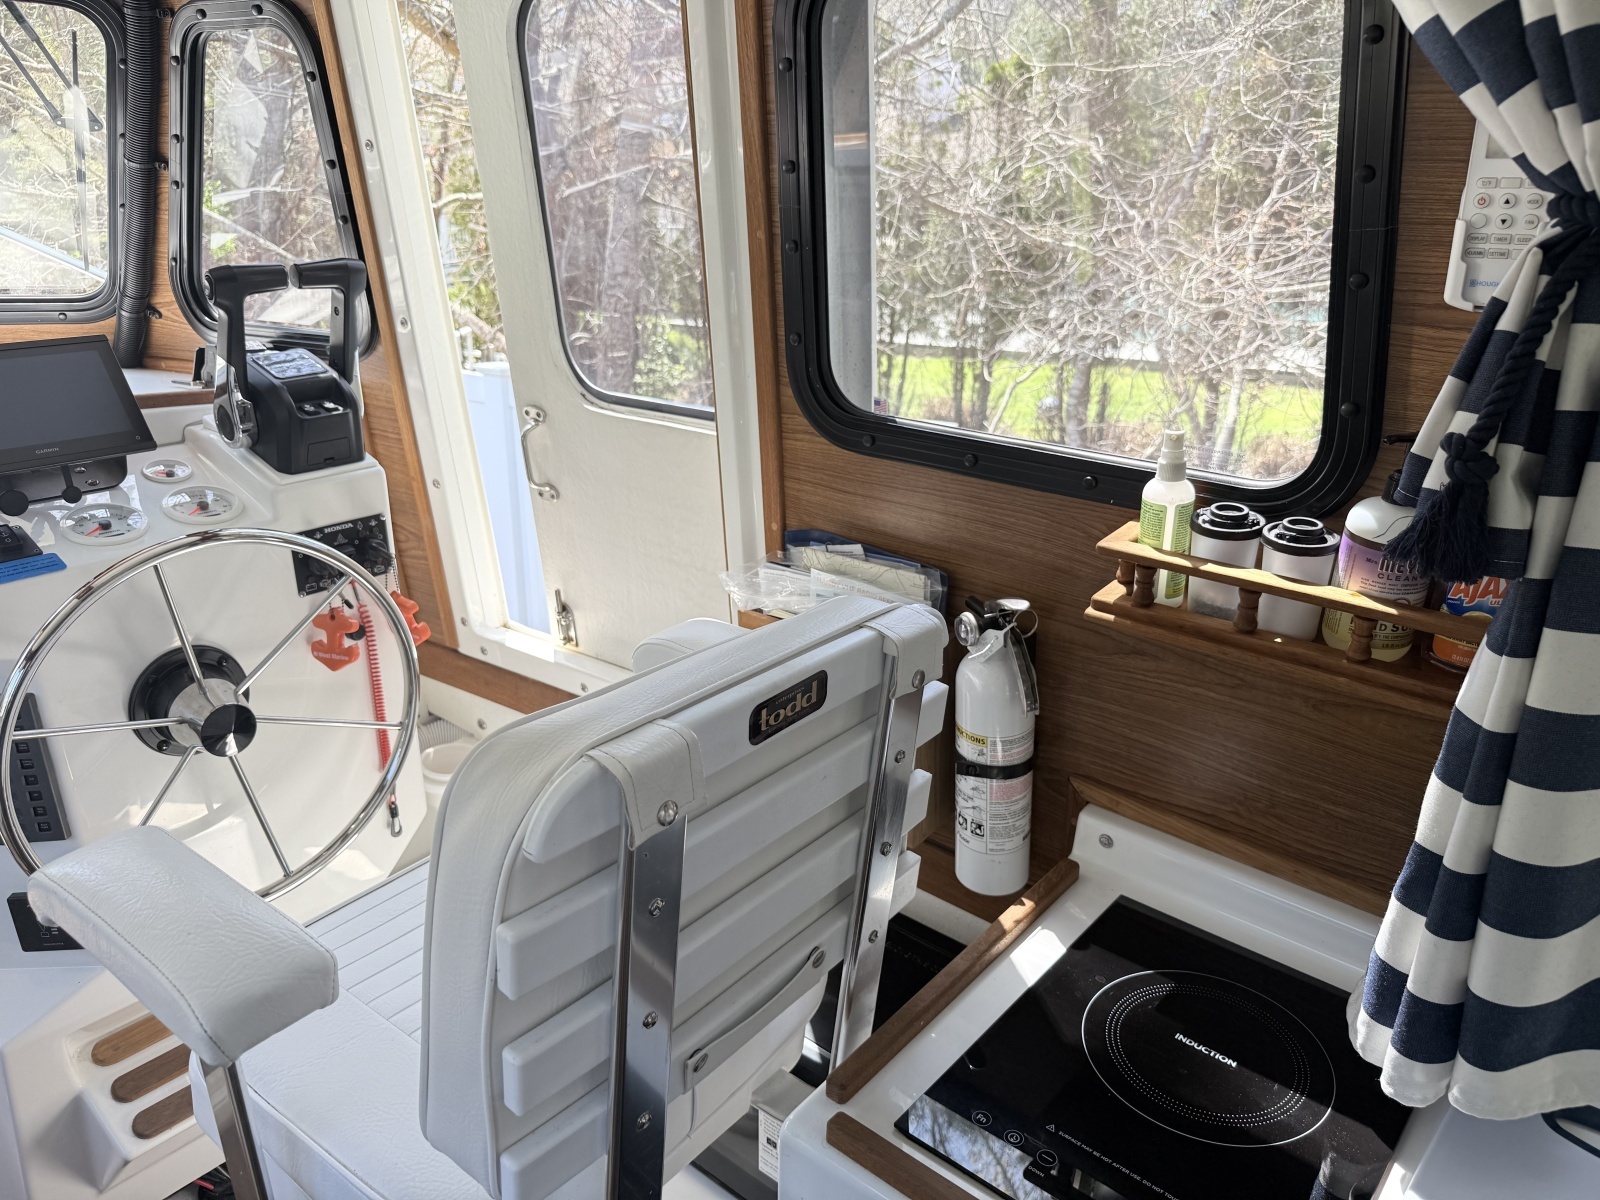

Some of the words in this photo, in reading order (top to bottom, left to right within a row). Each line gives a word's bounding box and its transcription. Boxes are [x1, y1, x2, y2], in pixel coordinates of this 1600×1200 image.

[35, 447, 60, 455] GARMIN
[324, 522, 354, 534] HONDA
[1377, 572, 1419, 582] CLEAN
[759, 680, 818, 731] todd
[1174, 1032, 1238, 1068] INDUCTION
[976, 1113, 987, 1124] Fn
[1027, 1164, 1045, 1178] DOWN
[1058, 1130, 1082, 1147] SURFACE
[1081, 1144, 1094, 1153] MAY
[1093, 1150, 1101, 1158] BE
[1100, 1155, 1113, 1164] HOT
[1112, 1162, 1130, 1175] AFTER
[1142, 1179, 1152, 1187] DO
[1151, 1184, 1165, 1194] NOT
[1164, 1191, 1180, 1200] TOU
